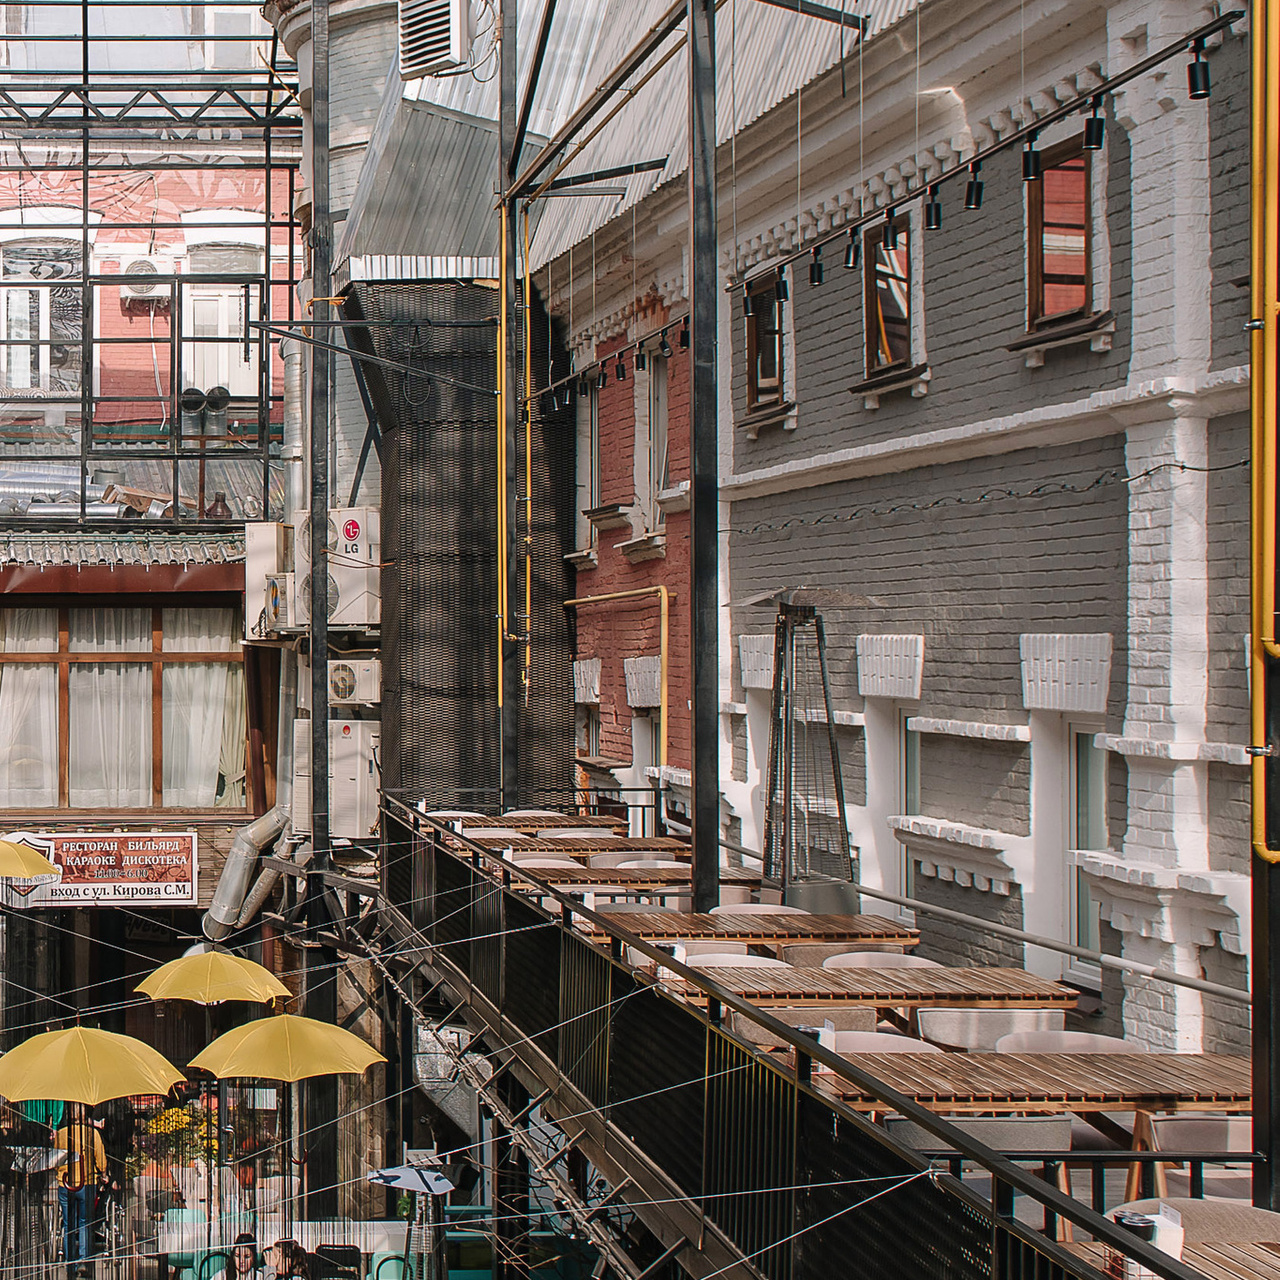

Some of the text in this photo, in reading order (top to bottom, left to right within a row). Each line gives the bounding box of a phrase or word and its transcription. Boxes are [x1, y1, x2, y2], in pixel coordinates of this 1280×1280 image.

[344, 543, 359, 554] LG
[62, 841, 180, 852] РЕСТОРАН БИЛЬЯРД
[66, 855, 188, 866] КАРАОКЕ ДИСКОТЕКА
[50, 884, 190, 899] вход с ул. Кирова С.М.
